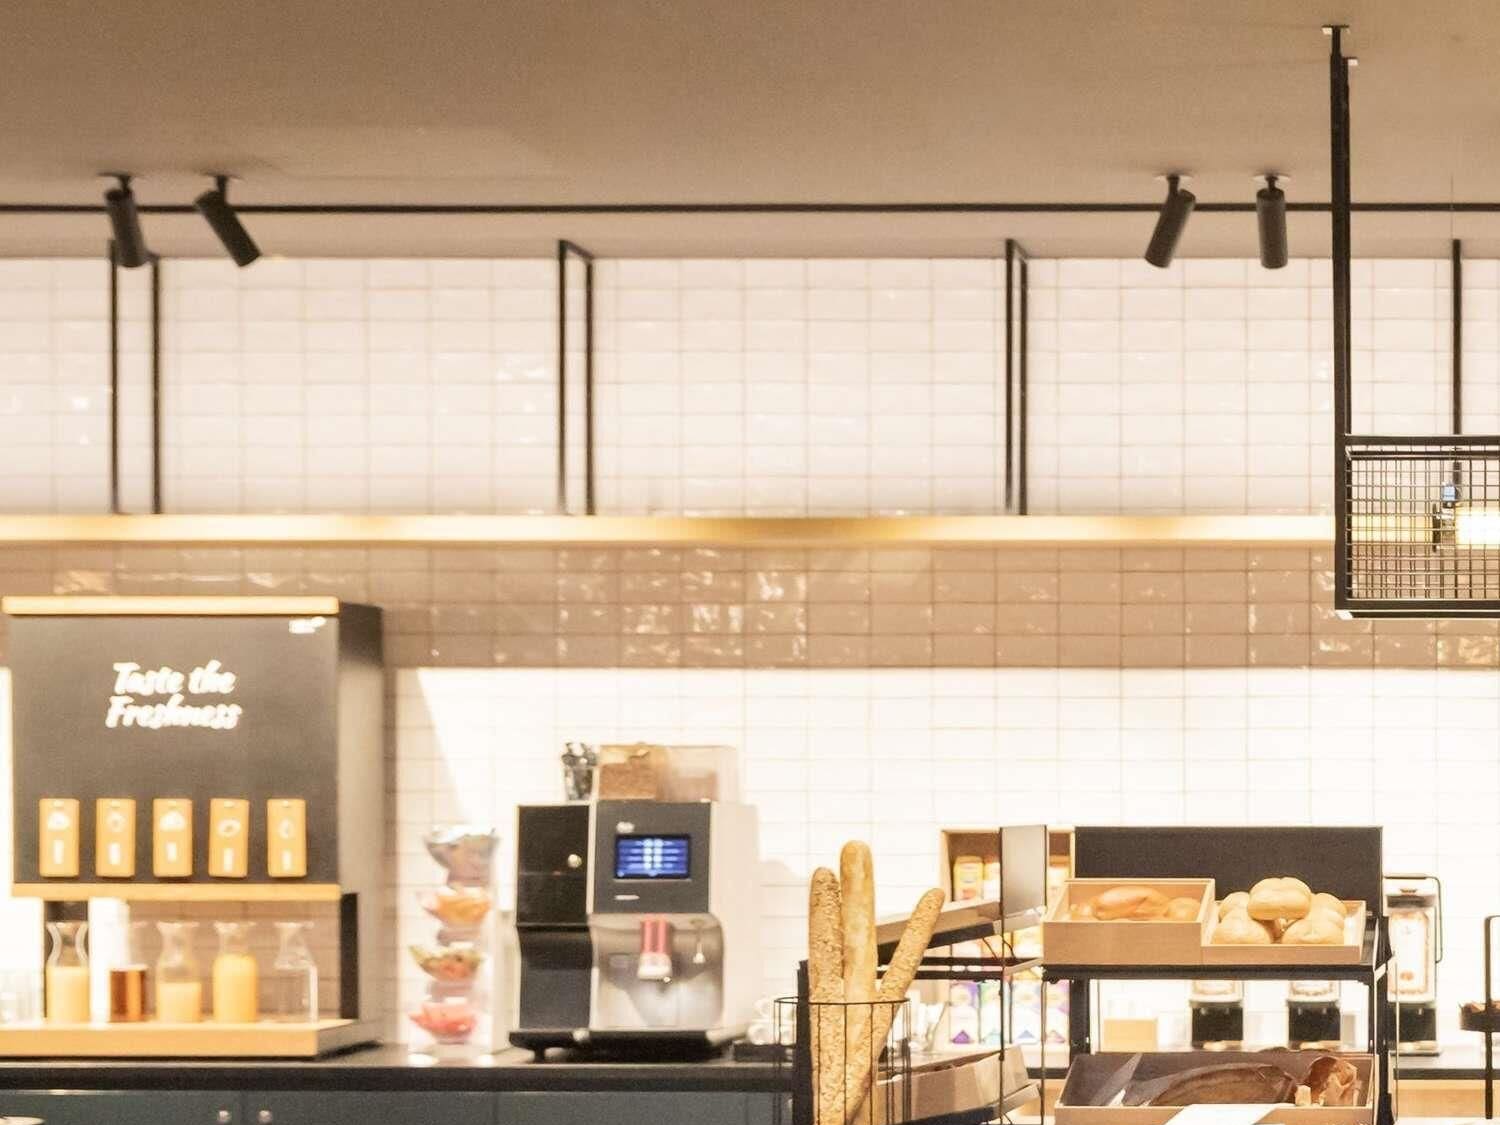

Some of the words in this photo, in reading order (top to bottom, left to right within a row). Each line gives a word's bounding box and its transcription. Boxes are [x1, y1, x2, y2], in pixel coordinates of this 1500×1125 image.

[113, 662, 185, 696] Taste
[188, 660, 236, 694] the
[105, 693, 243, 729] Freshness
